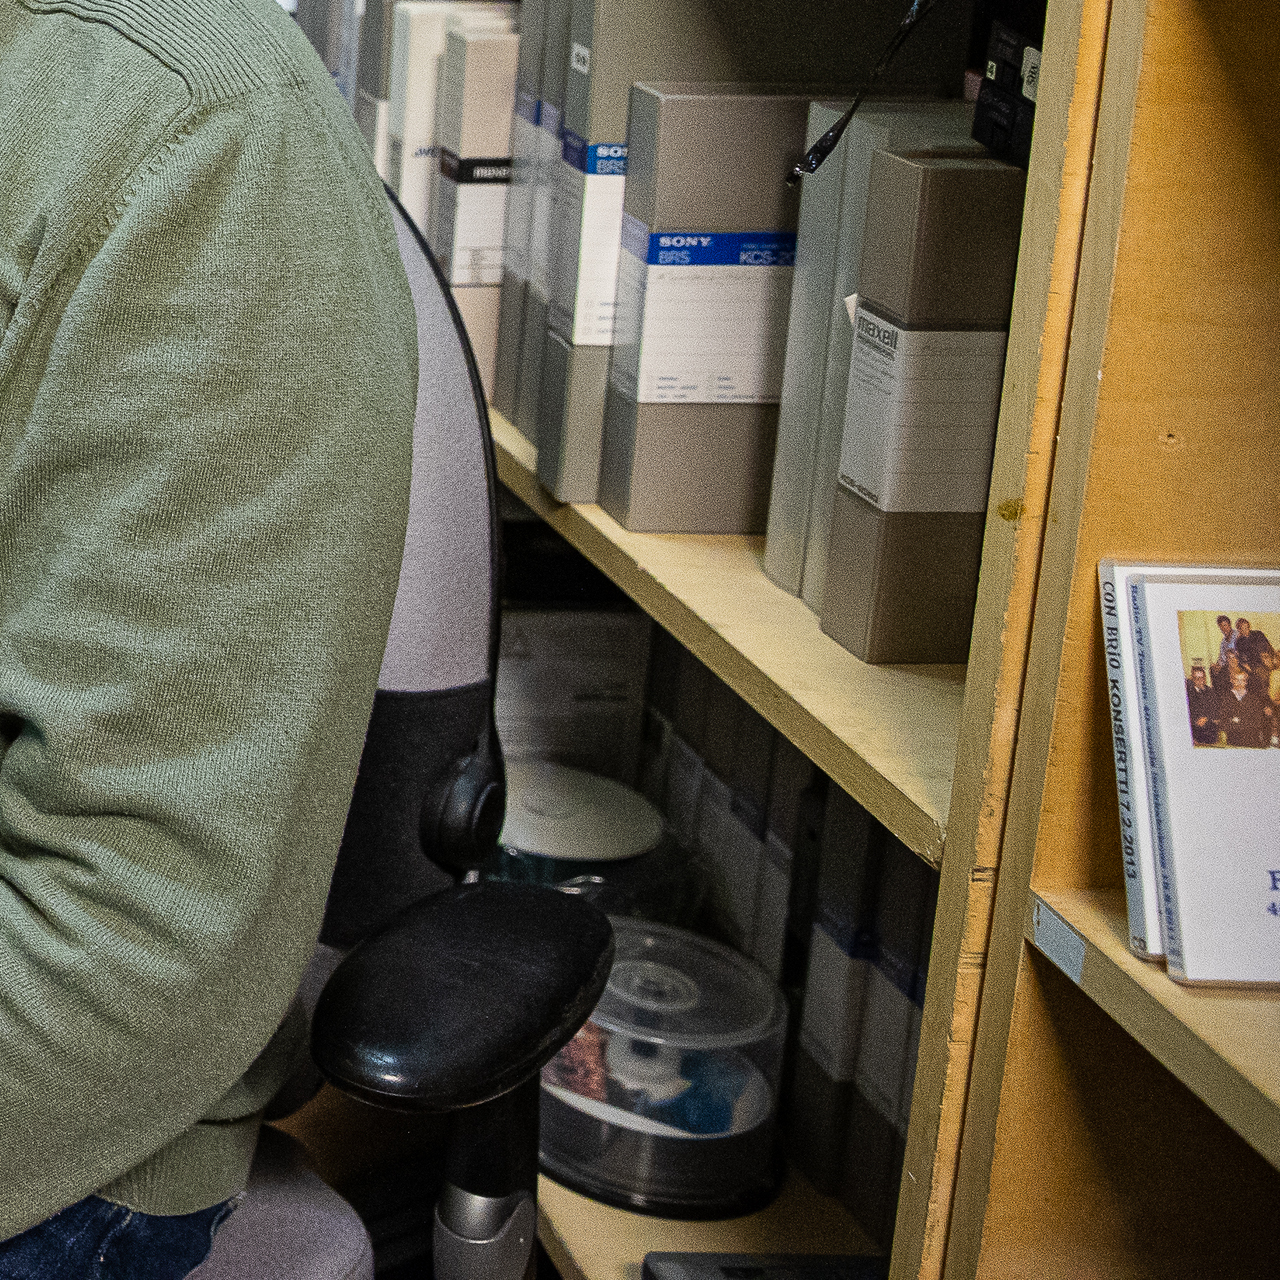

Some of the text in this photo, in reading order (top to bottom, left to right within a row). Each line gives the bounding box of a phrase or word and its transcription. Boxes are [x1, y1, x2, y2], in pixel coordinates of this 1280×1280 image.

[658, 235, 713, 248] SONY
[658, 250, 690, 265] BRS
[857, 317, 899, 351] maxell
[1101, 581, 1117, 619] CON
[1109, 678, 1131, 790] KONSERTTI
[1116, 800, 1137, 882] 7.2.2013
